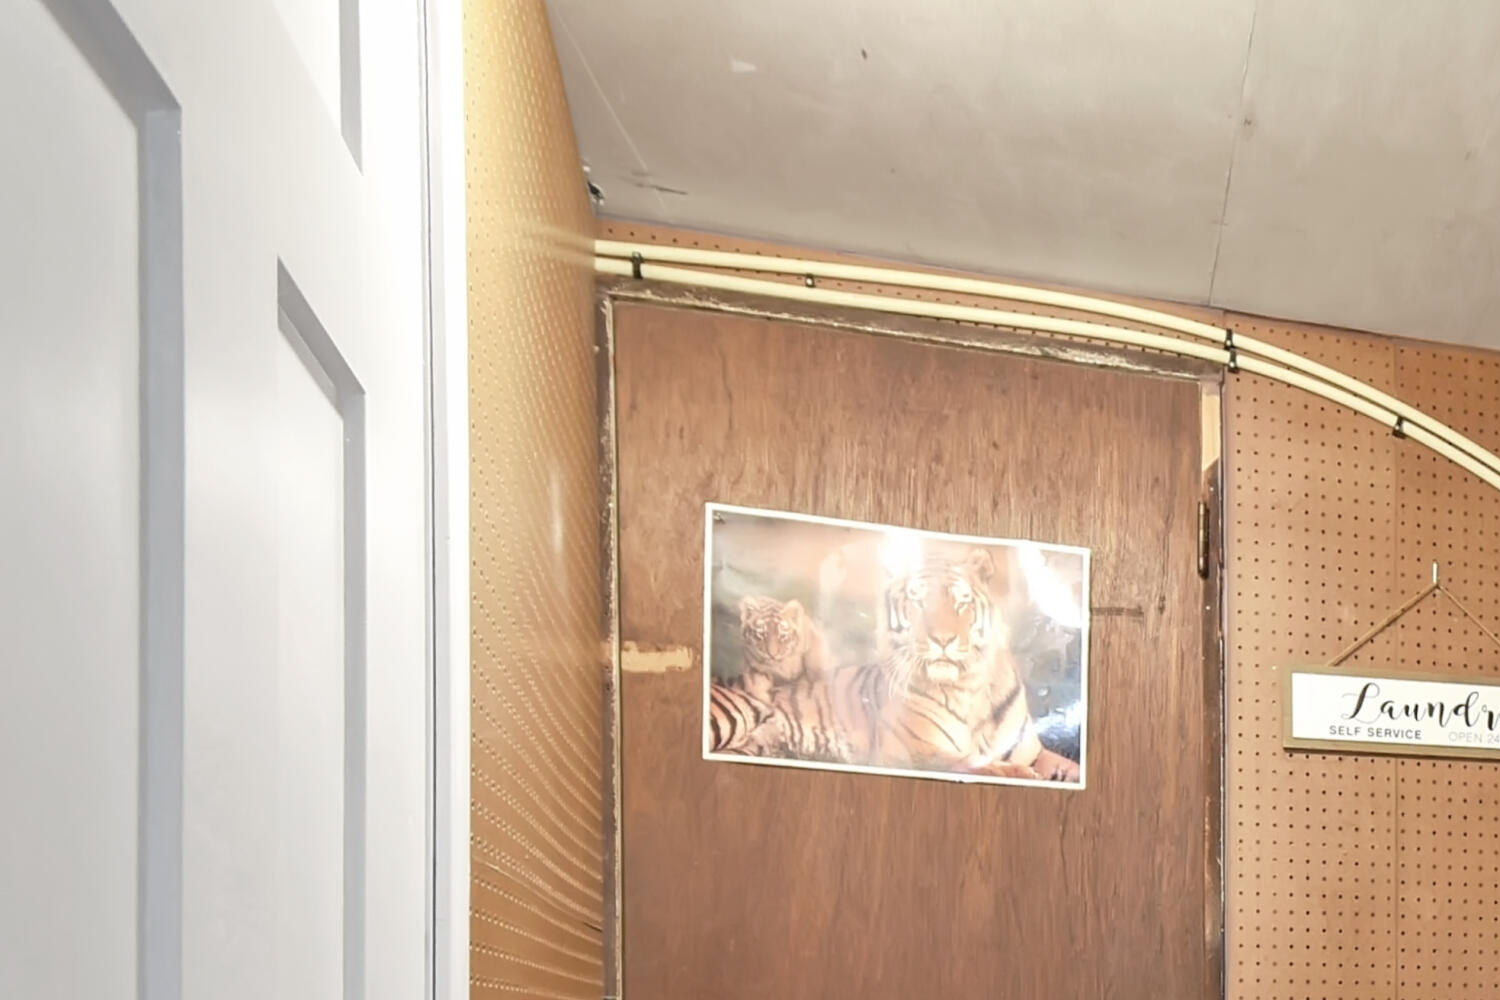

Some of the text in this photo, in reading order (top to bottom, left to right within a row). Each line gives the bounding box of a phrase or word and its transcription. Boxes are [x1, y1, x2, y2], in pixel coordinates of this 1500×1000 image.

[1329, 725, 1422, 740] SELF SERVICE
[1449, 731, 1483, 744] OPEN
[1487, 734, 1500, 745] 24
